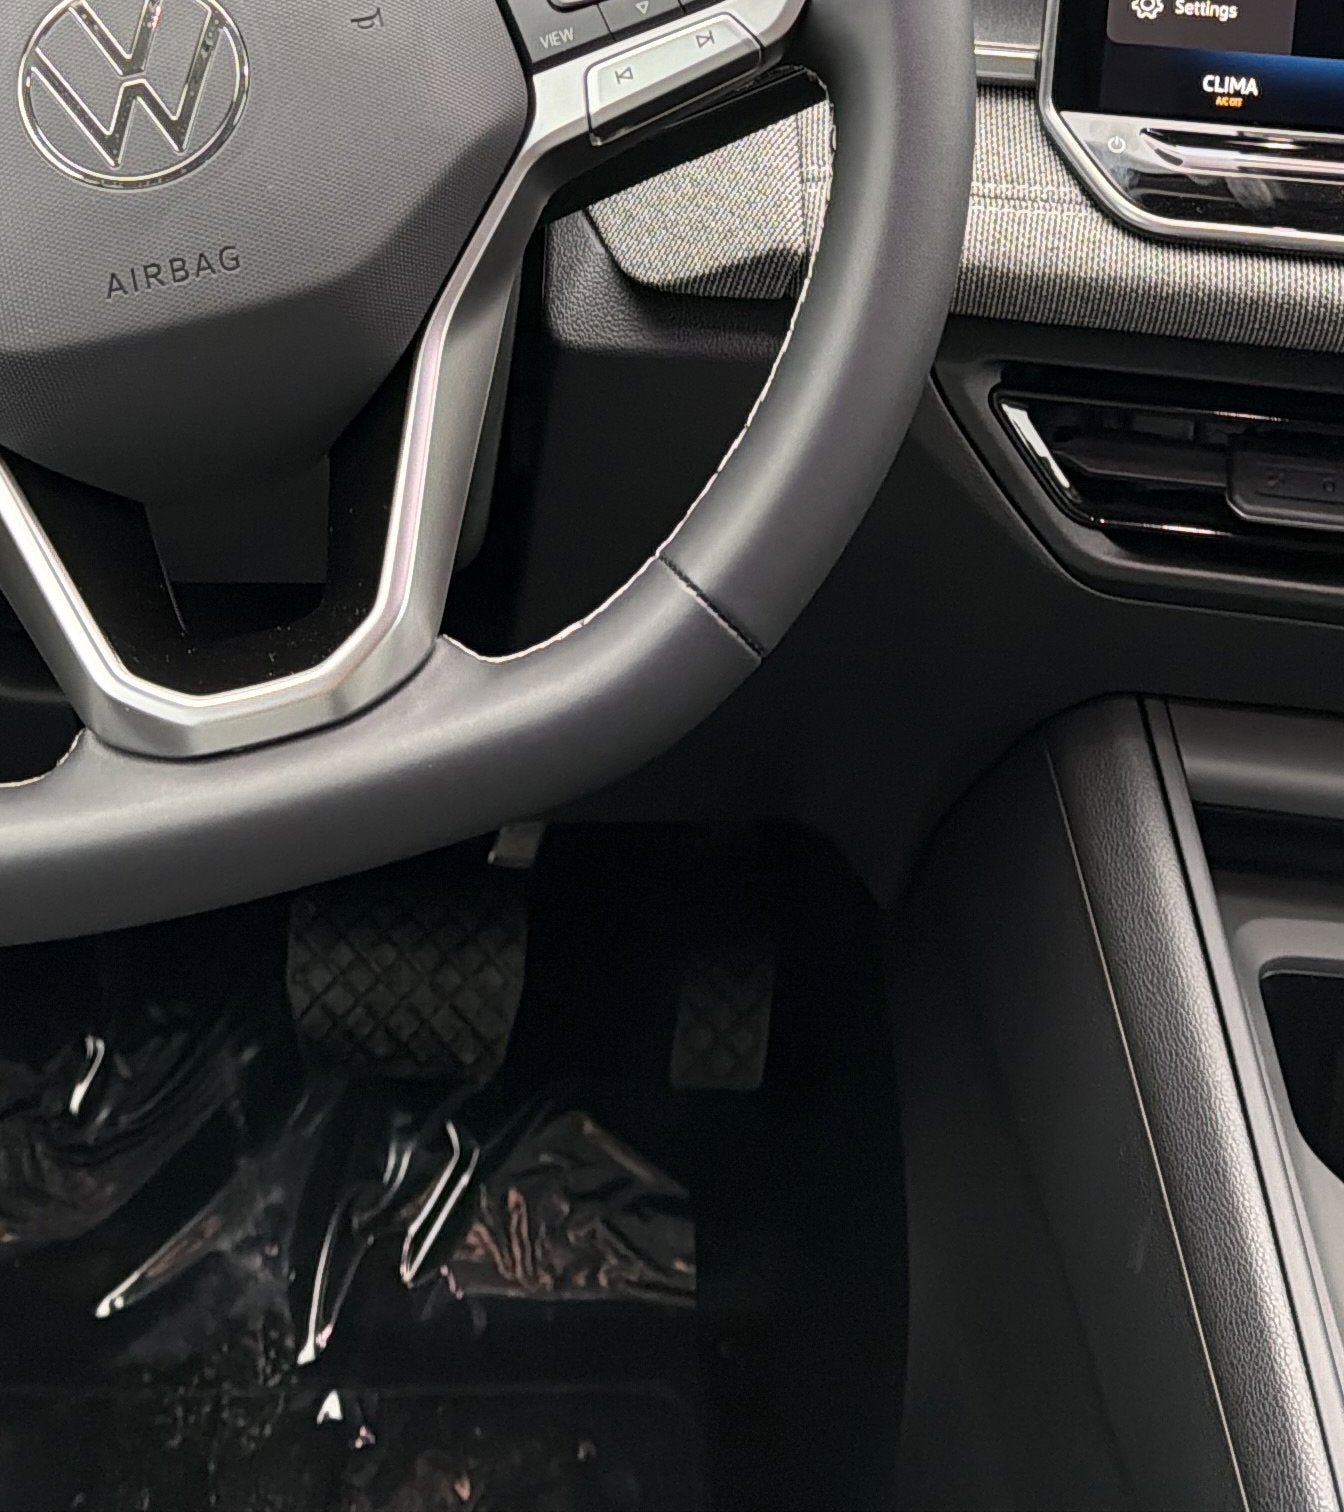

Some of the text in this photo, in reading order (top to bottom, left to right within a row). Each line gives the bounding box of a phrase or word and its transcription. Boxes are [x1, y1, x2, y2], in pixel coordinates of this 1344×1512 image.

[539, 26, 574, 49] VIEW
[1202, 74, 1259, 97] CLIMA
[105, 244, 242, 299] AIRBAG
